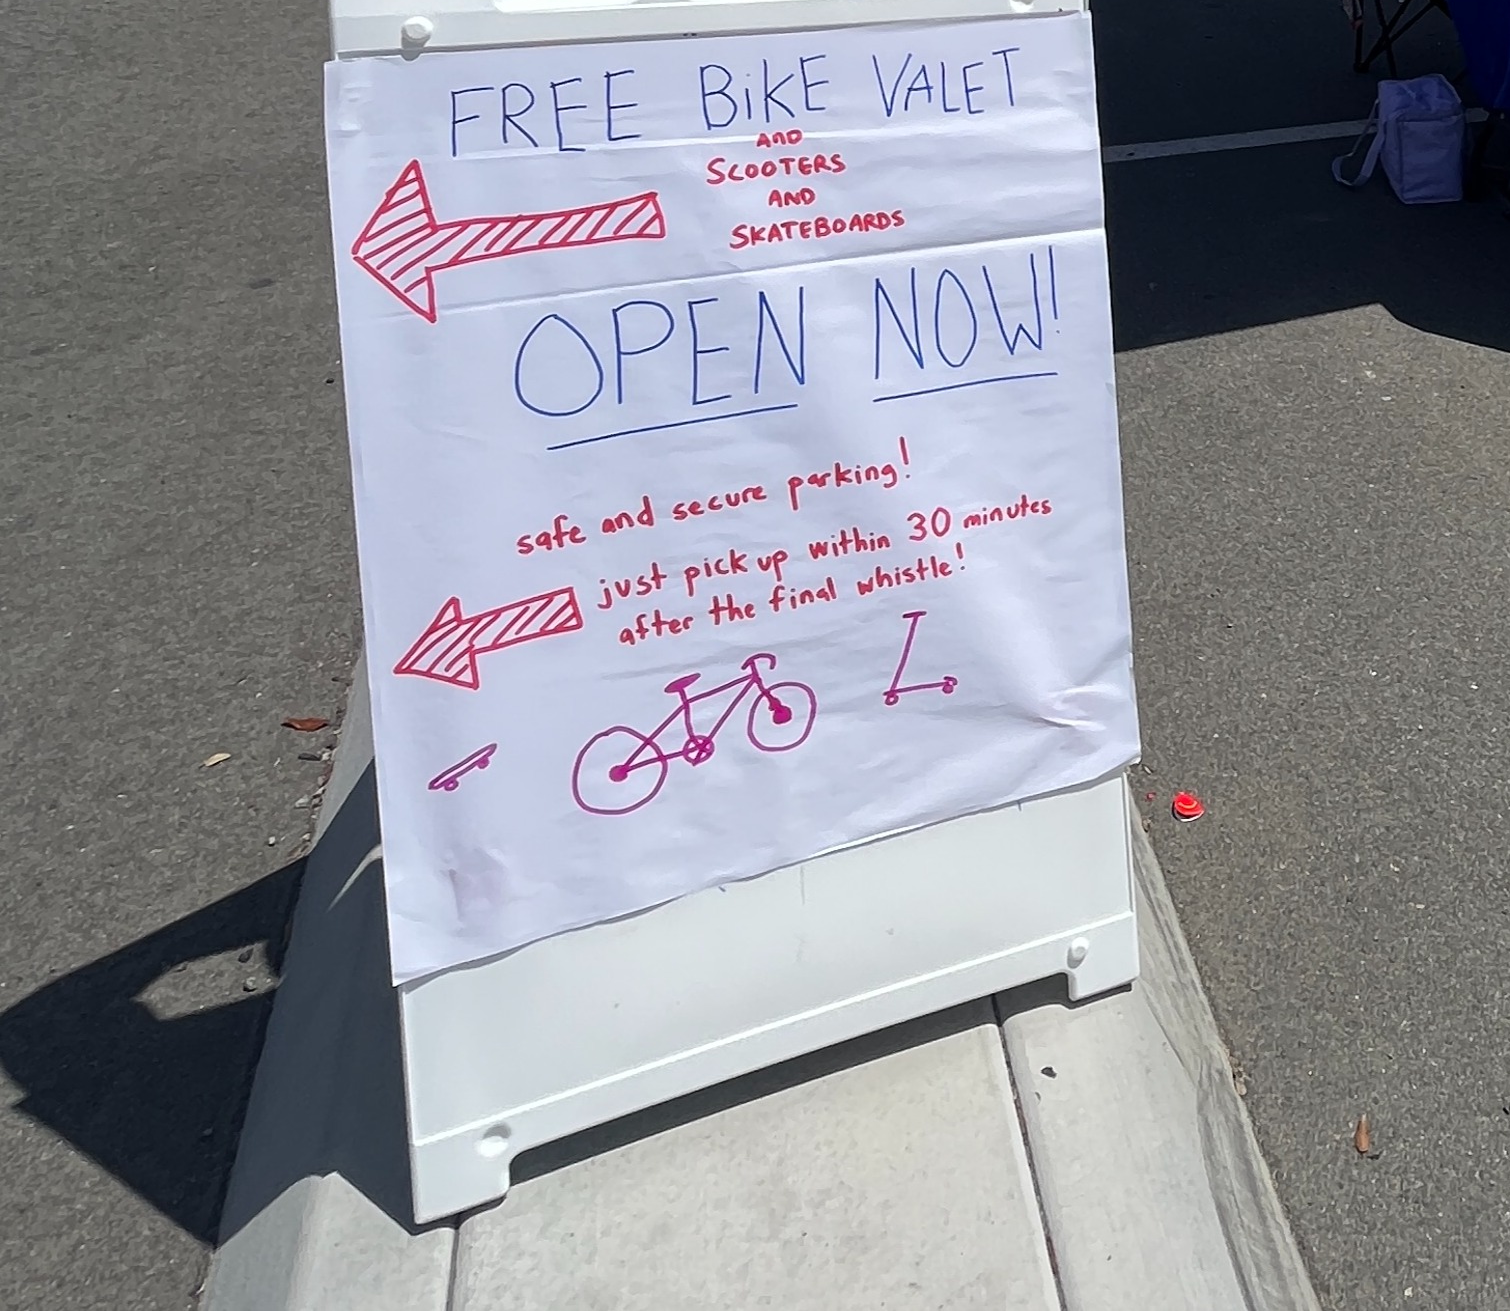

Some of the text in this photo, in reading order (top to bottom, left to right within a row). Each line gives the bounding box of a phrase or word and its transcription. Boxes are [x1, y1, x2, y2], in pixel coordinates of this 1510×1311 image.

[451, 69, 641, 157] FREE
[873, 48, 1021, 118] VALET
[706, 154, 847, 185] SCOOTERS
[768, 187, 816, 208] AND
[729, 210, 906, 250] SKATEBOARDS
[514, 245, 1061, 417] OPEN NOW!
[516, 437, 911, 555] safe and secure parking!
[597, 494, 1053, 611] just pick up within 30 minutes
[619, 542, 967, 646] after the final whistle!
